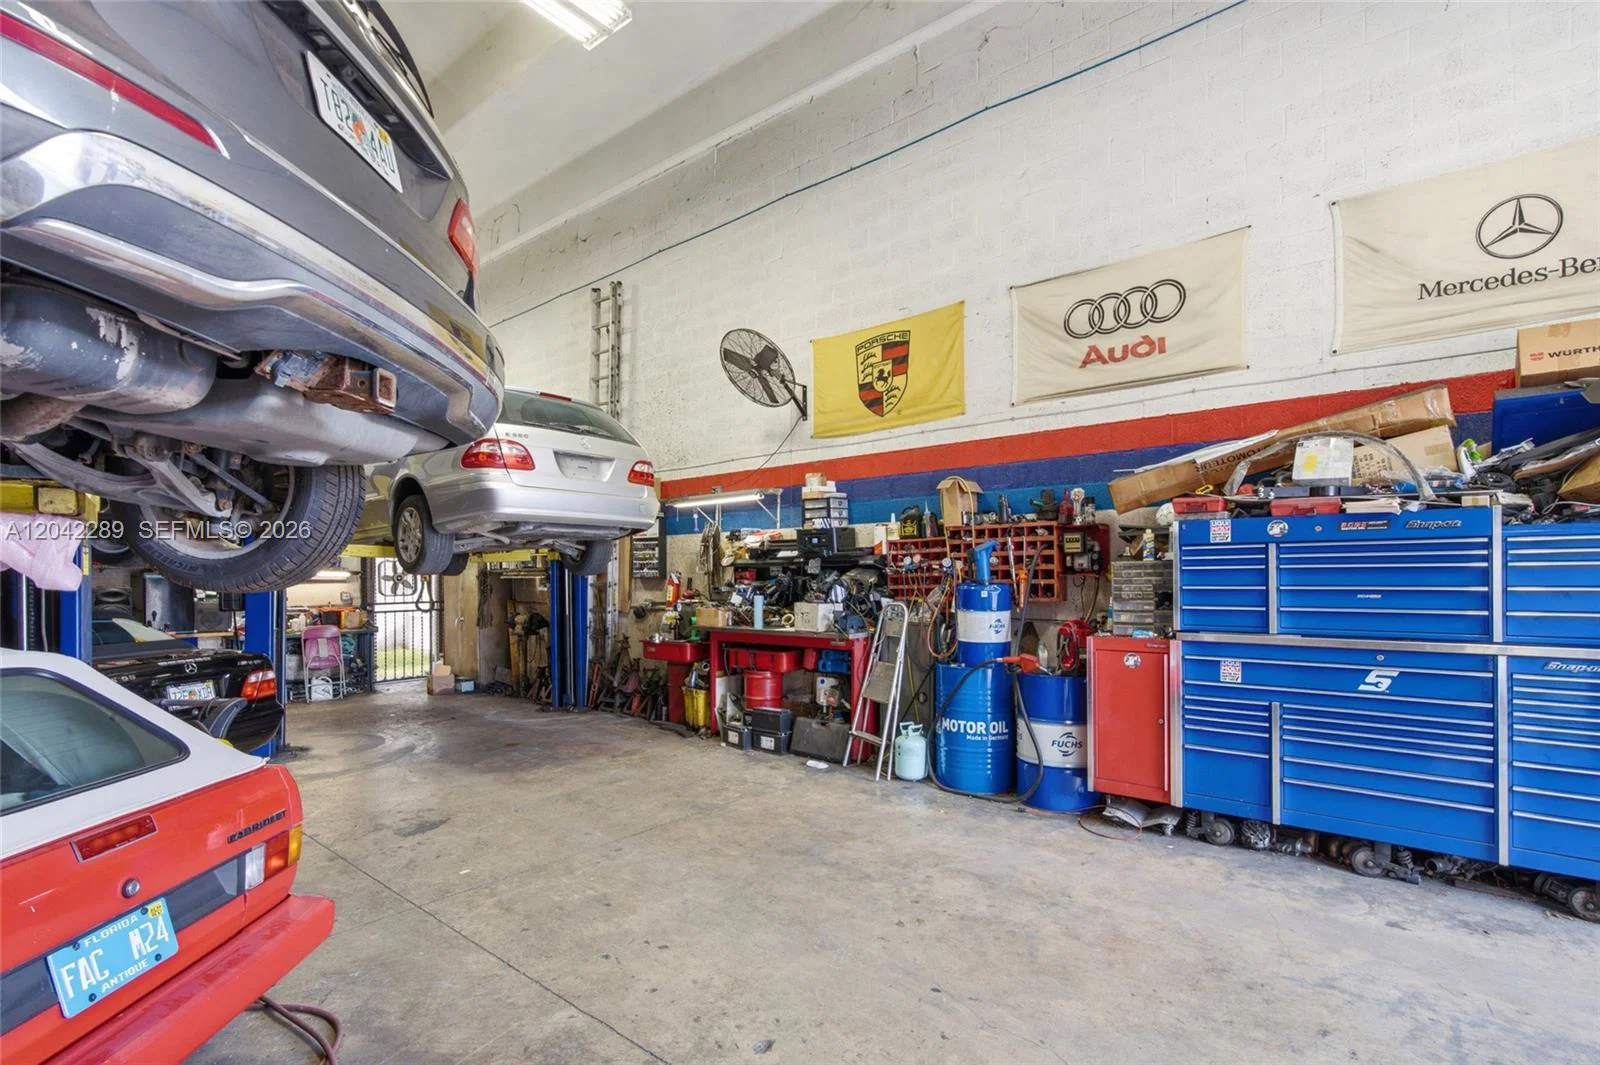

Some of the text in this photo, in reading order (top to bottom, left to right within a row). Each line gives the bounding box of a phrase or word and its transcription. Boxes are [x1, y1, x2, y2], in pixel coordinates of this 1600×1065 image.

[857, 332, 908, 353] PORSCHE
[1079, 335, 1166, 369] Audi
[942, 717, 987, 735] MOTOR
[989, 720, 1009, 735] OIL
[1051, 739, 1083, 749] FUCHS
[83, 914, 138, 948] FLORIDA
[60, 914, 169, 1000] FAC M24
[101, 958, 150, 993] ANTIQUE
